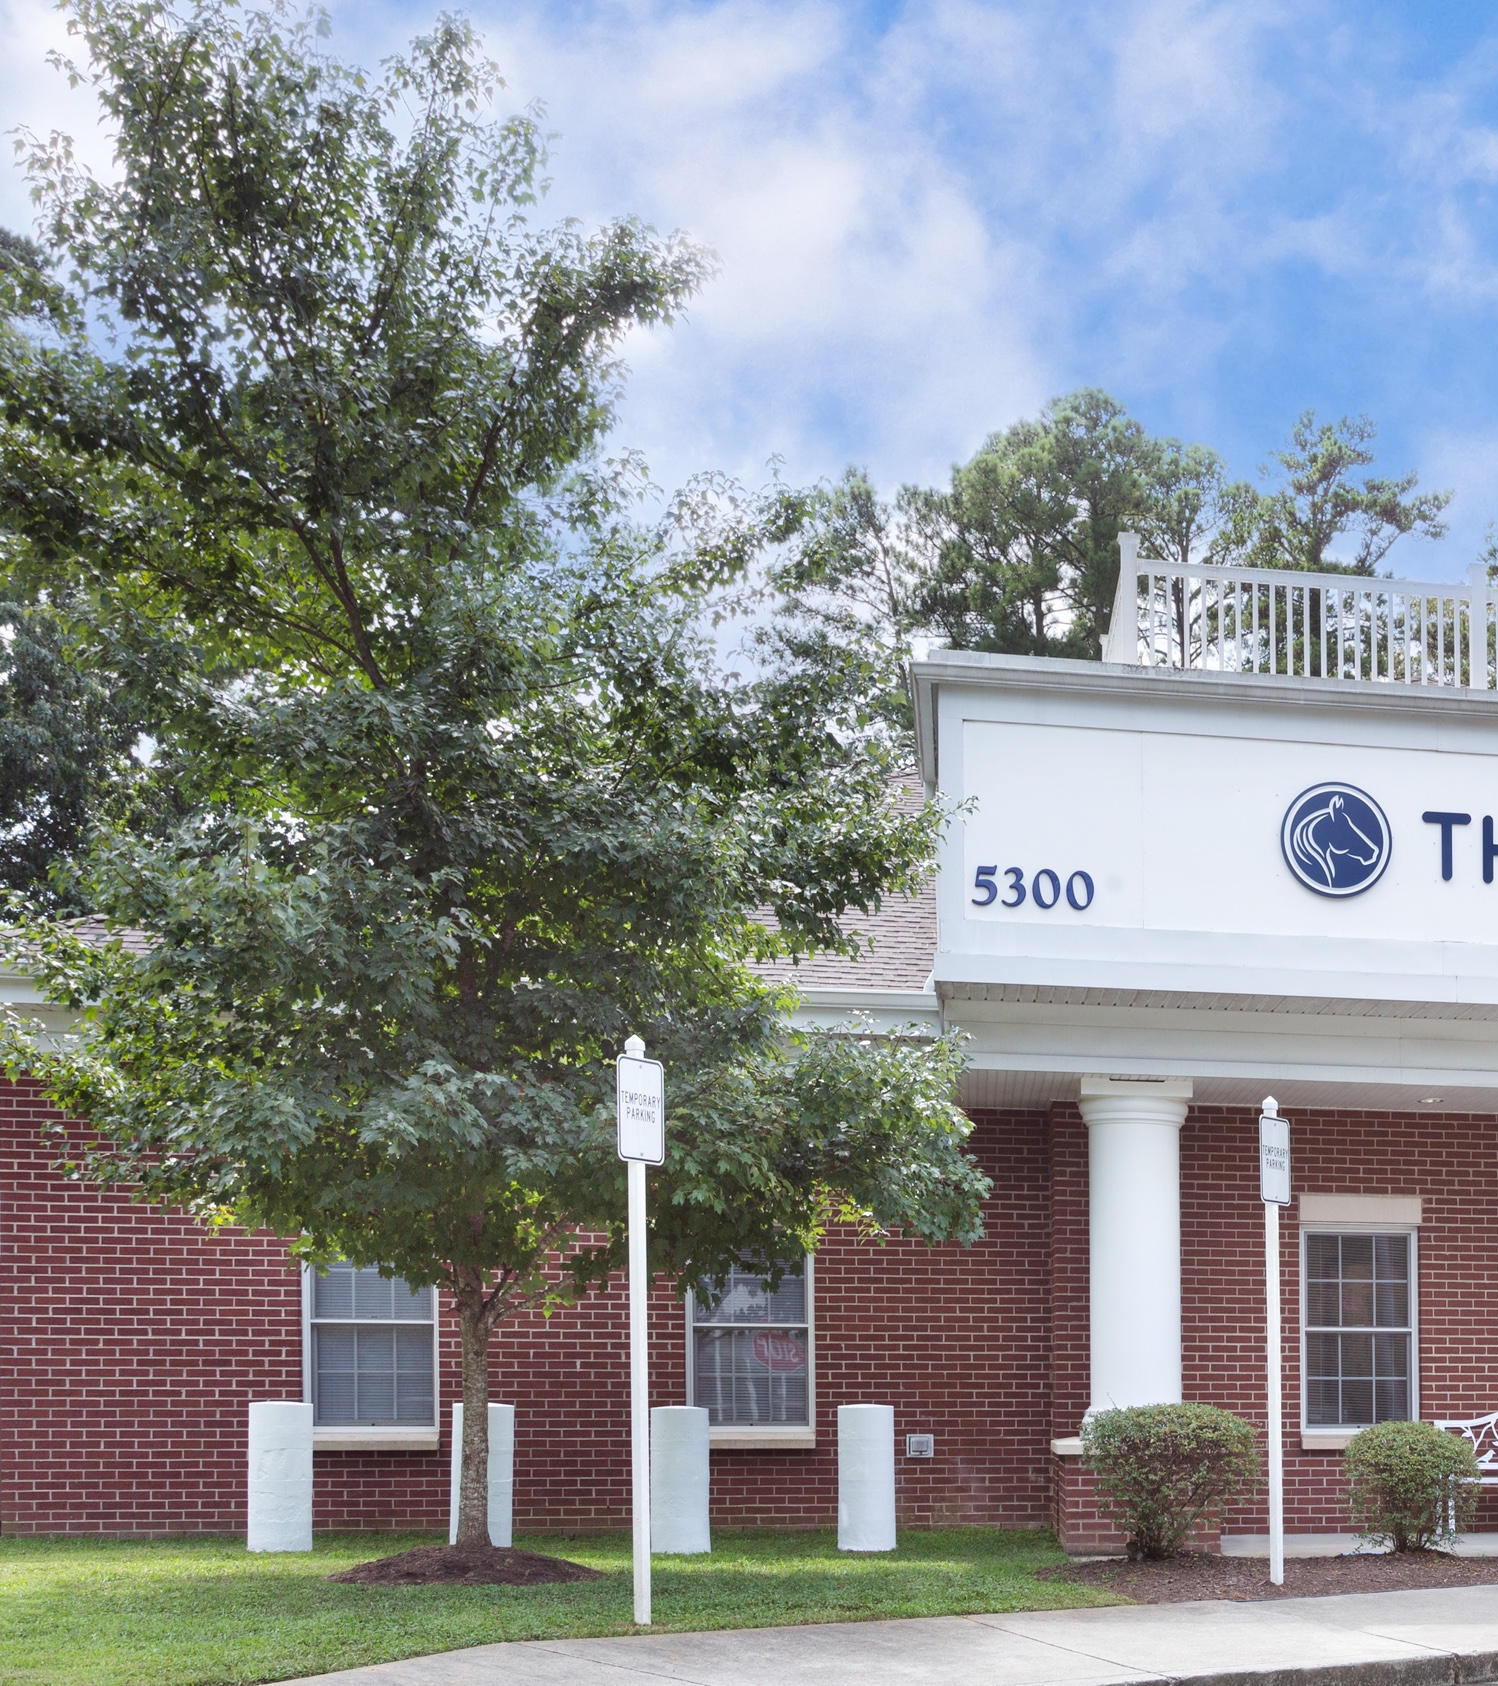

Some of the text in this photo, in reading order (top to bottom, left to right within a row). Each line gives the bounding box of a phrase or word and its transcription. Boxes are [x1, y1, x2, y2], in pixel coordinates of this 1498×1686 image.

[971, 864, 1095, 910] 5300
[621, 1090, 661, 1109] TEMPORARY
[626, 1106, 656, 1123] PARKING
[1262, 1144, 1288, 1159] TEMPORARY
[1266, 1158, 1285, 1171] PARKING
